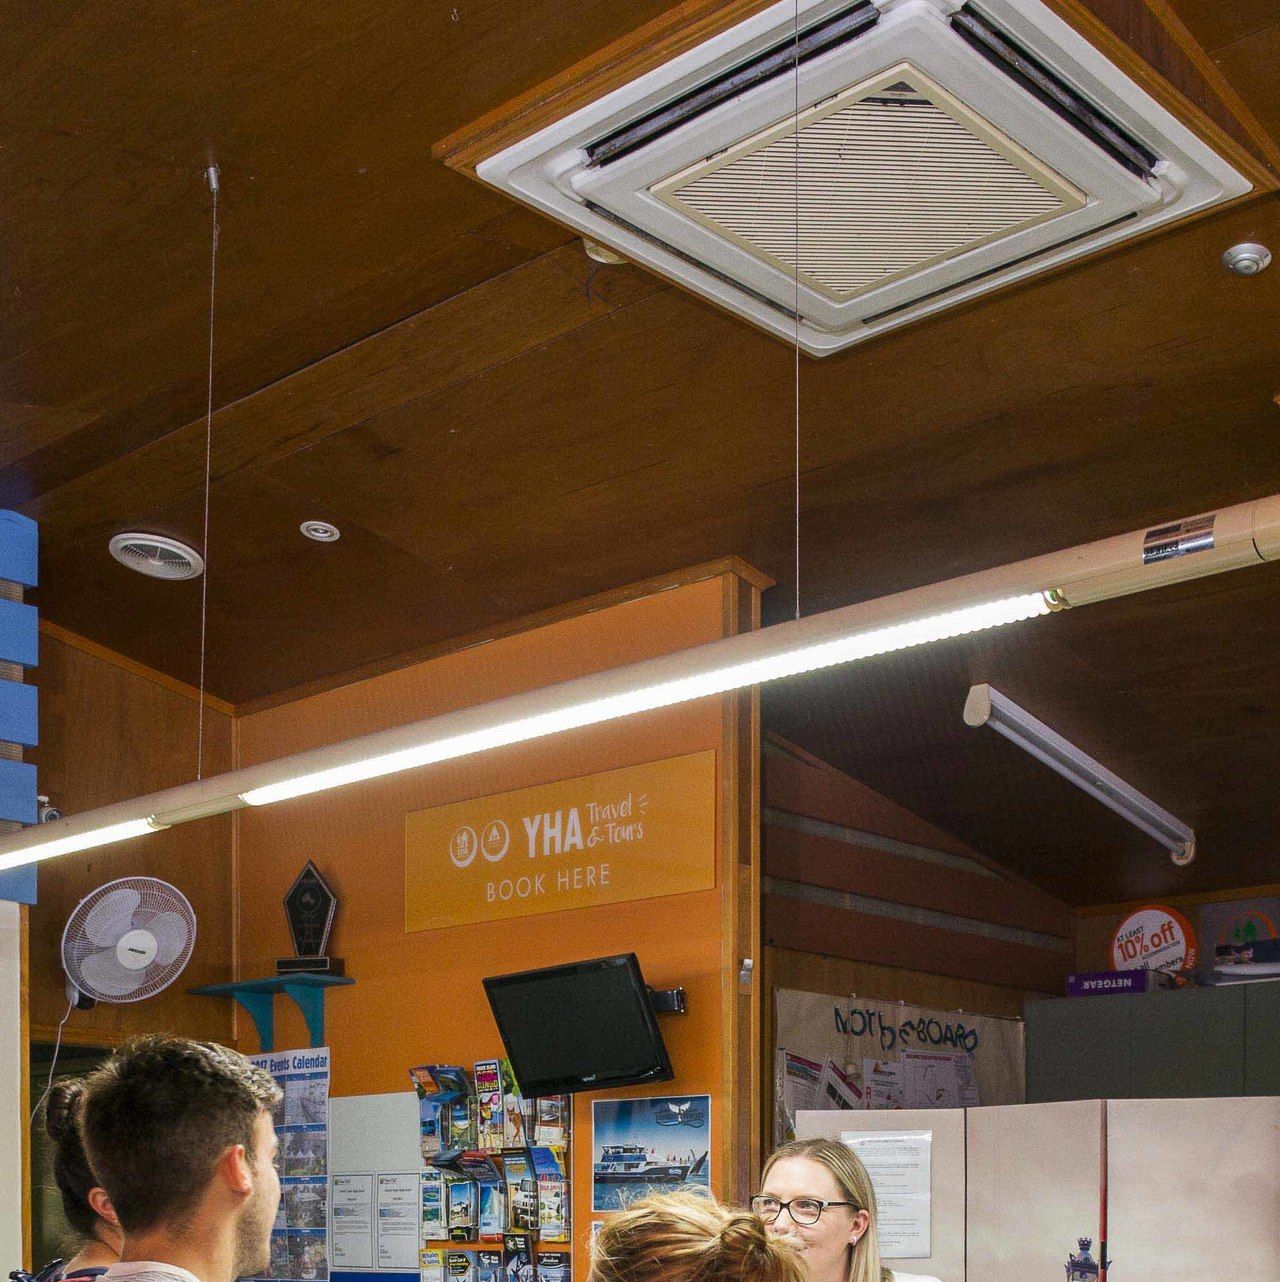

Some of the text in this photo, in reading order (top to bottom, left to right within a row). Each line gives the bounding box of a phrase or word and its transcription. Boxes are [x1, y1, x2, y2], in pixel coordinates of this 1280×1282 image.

[522, 793, 632, 858] YHA Travel
[604, 822, 644, 845] Tours
[486, 863, 611, 903] BOOK HERE
[1117, 921, 1176, 962] 10% off
[1082, 979, 1132, 990] NETGEAR
[270, 1057, 290, 1073] Events
[292, 1053, 328, 1070] Calendar
